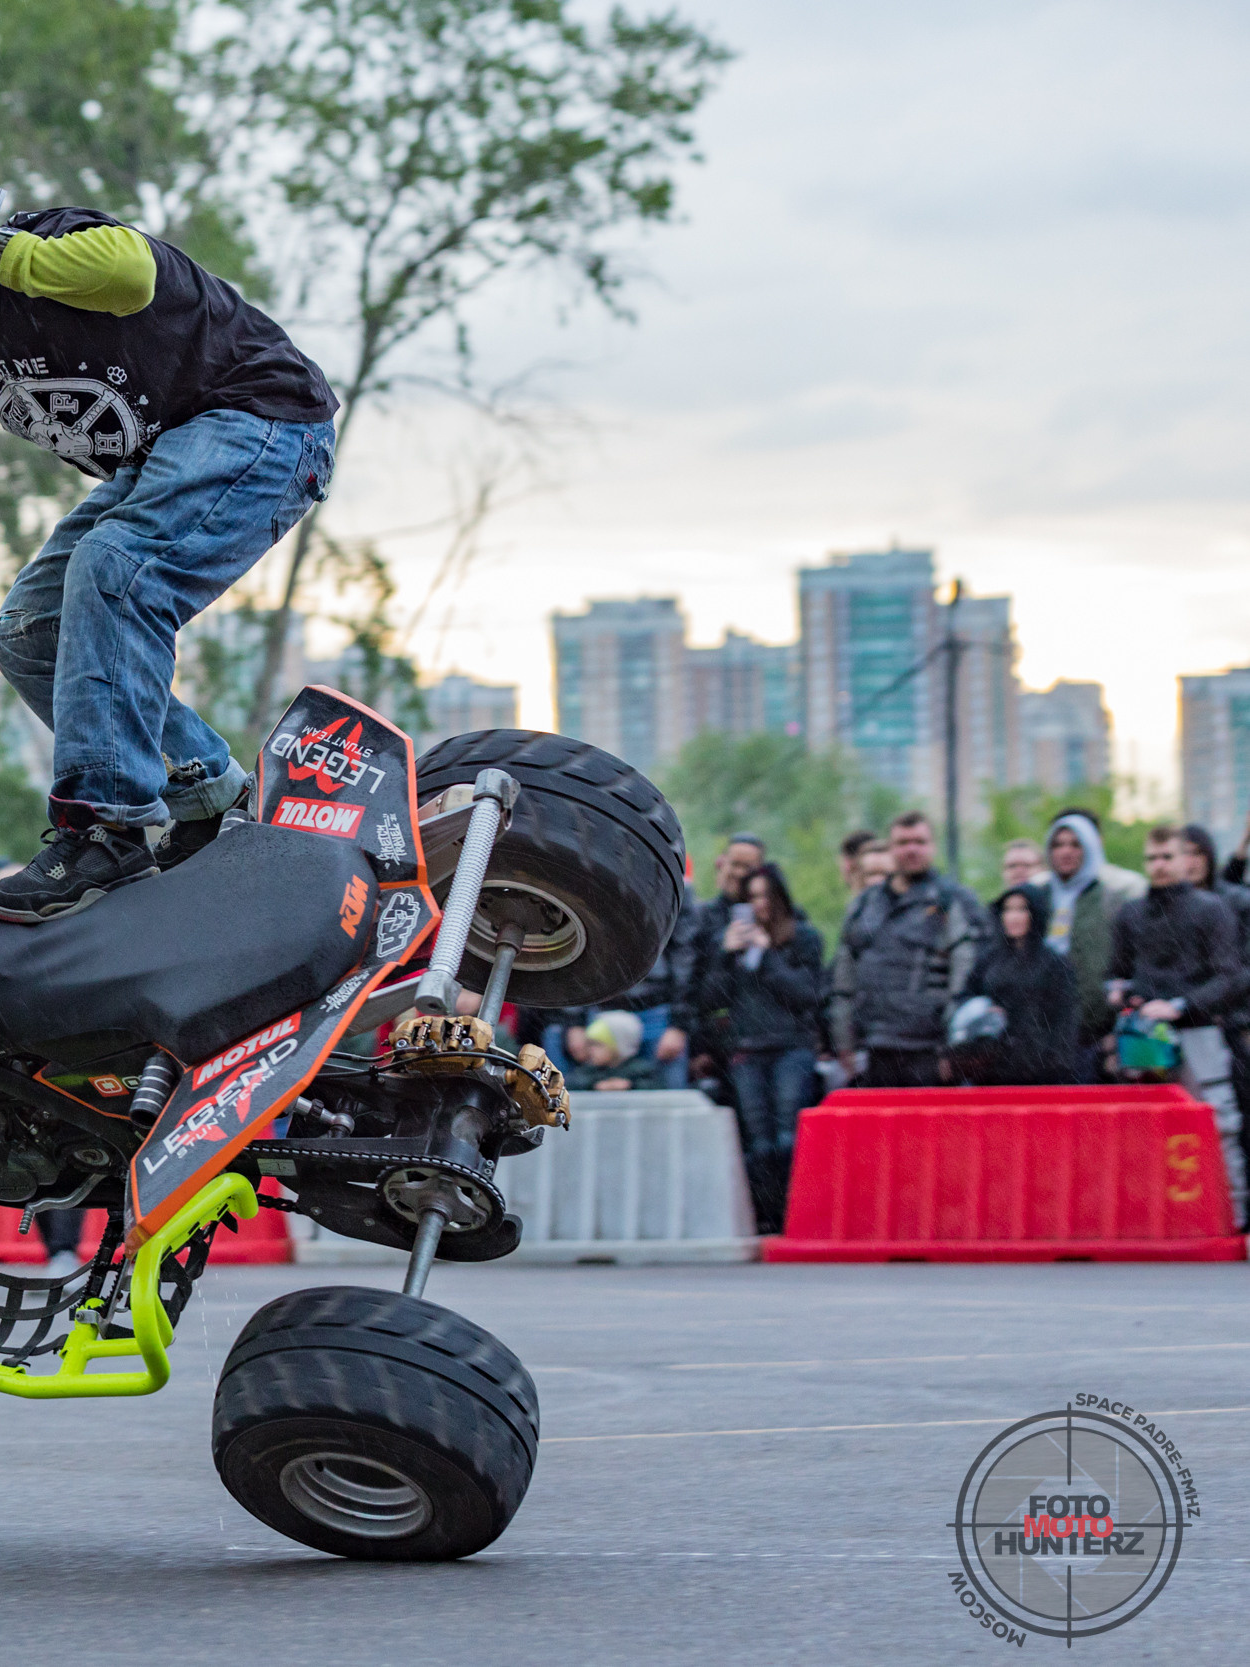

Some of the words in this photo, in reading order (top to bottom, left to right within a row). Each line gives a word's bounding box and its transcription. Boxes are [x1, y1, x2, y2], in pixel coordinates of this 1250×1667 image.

[12, 357, 49, 375] ME
[270, 733, 386, 794] LEGEND
[302, 725, 334, 744] TEAM
[332, 736, 374, 758] STUNT
[278, 801, 359, 833] MOTUL
[339, 874, 369, 939] KTM
[197, 1019, 294, 1086] MOTUL
[143, 1038, 298, 1175] LEGEND
[176, 1110, 227, 1158] STUNT
[228, 1070, 275, 1108] TEAM
